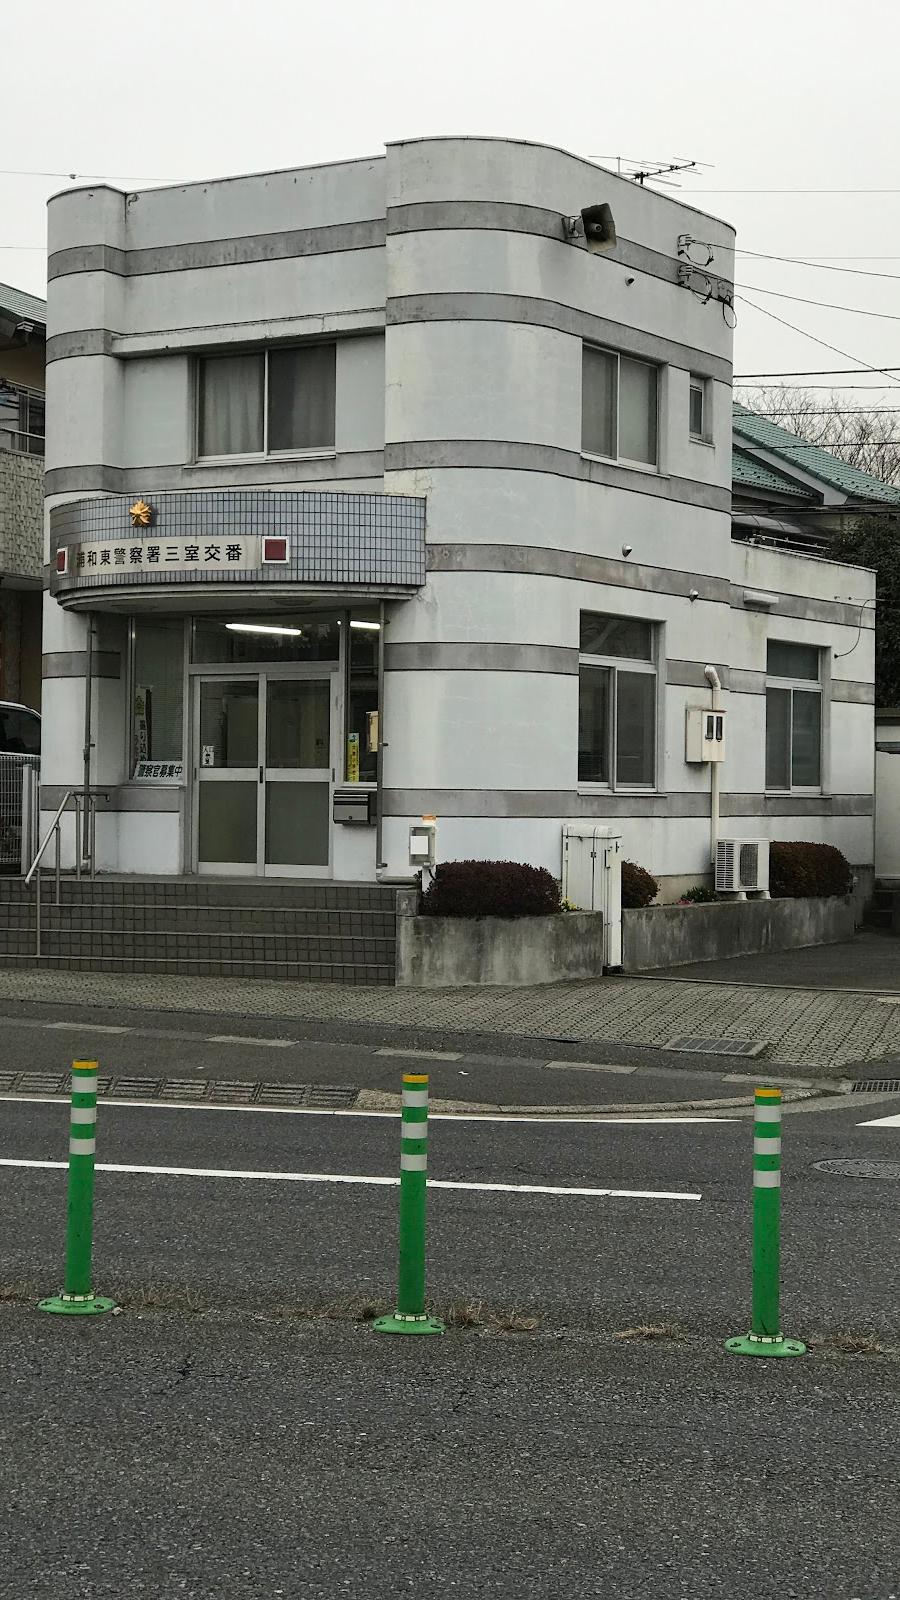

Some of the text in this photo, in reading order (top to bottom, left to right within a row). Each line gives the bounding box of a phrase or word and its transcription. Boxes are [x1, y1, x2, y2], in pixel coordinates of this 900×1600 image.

[76, 543, 243, 568] 浦和東警察署三室交番
